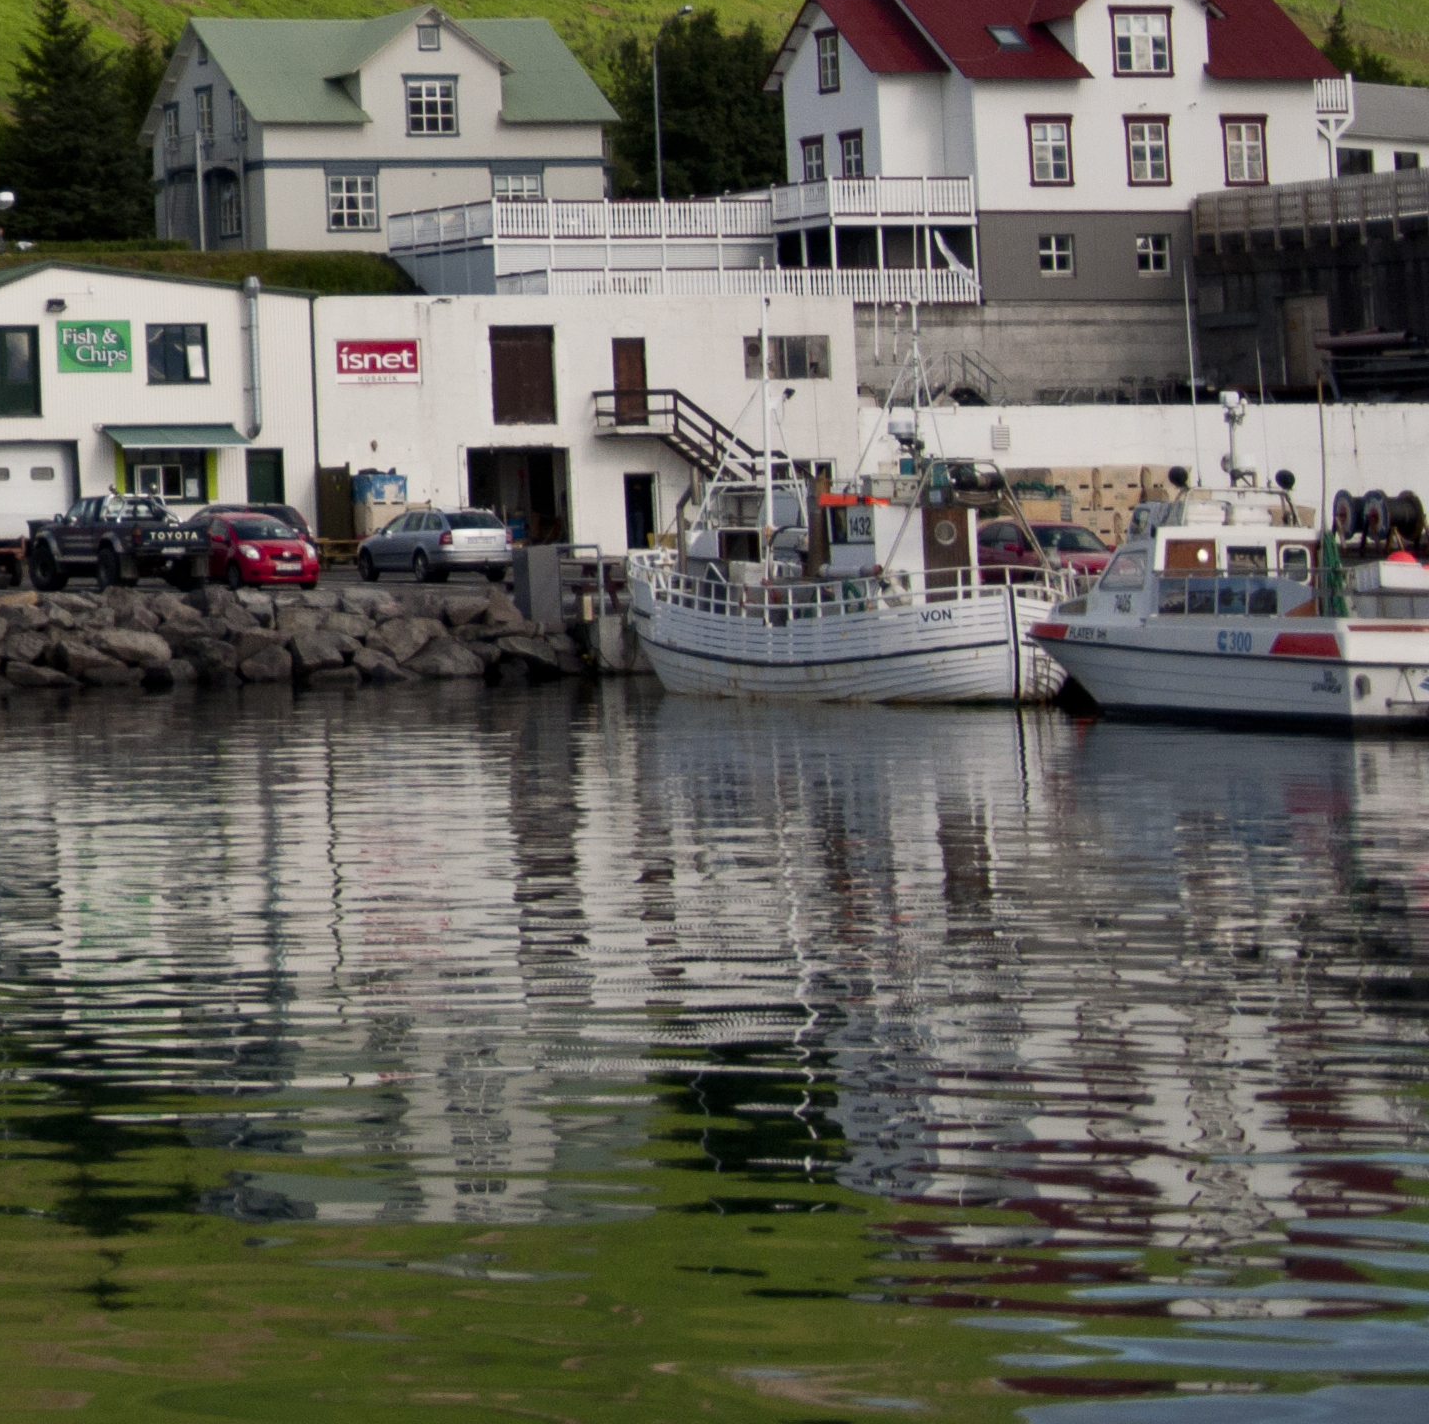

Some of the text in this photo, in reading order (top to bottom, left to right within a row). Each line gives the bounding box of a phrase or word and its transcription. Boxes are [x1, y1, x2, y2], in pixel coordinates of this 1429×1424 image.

[62, 327, 117, 345] Fish &
[76, 345, 127, 367] Chips
[339, 346, 415, 370] ísnet
[849, 517, 871, 535] 1432
[150, 531, 198, 540] TOYOTA
[920, 609, 952, 622] VON
